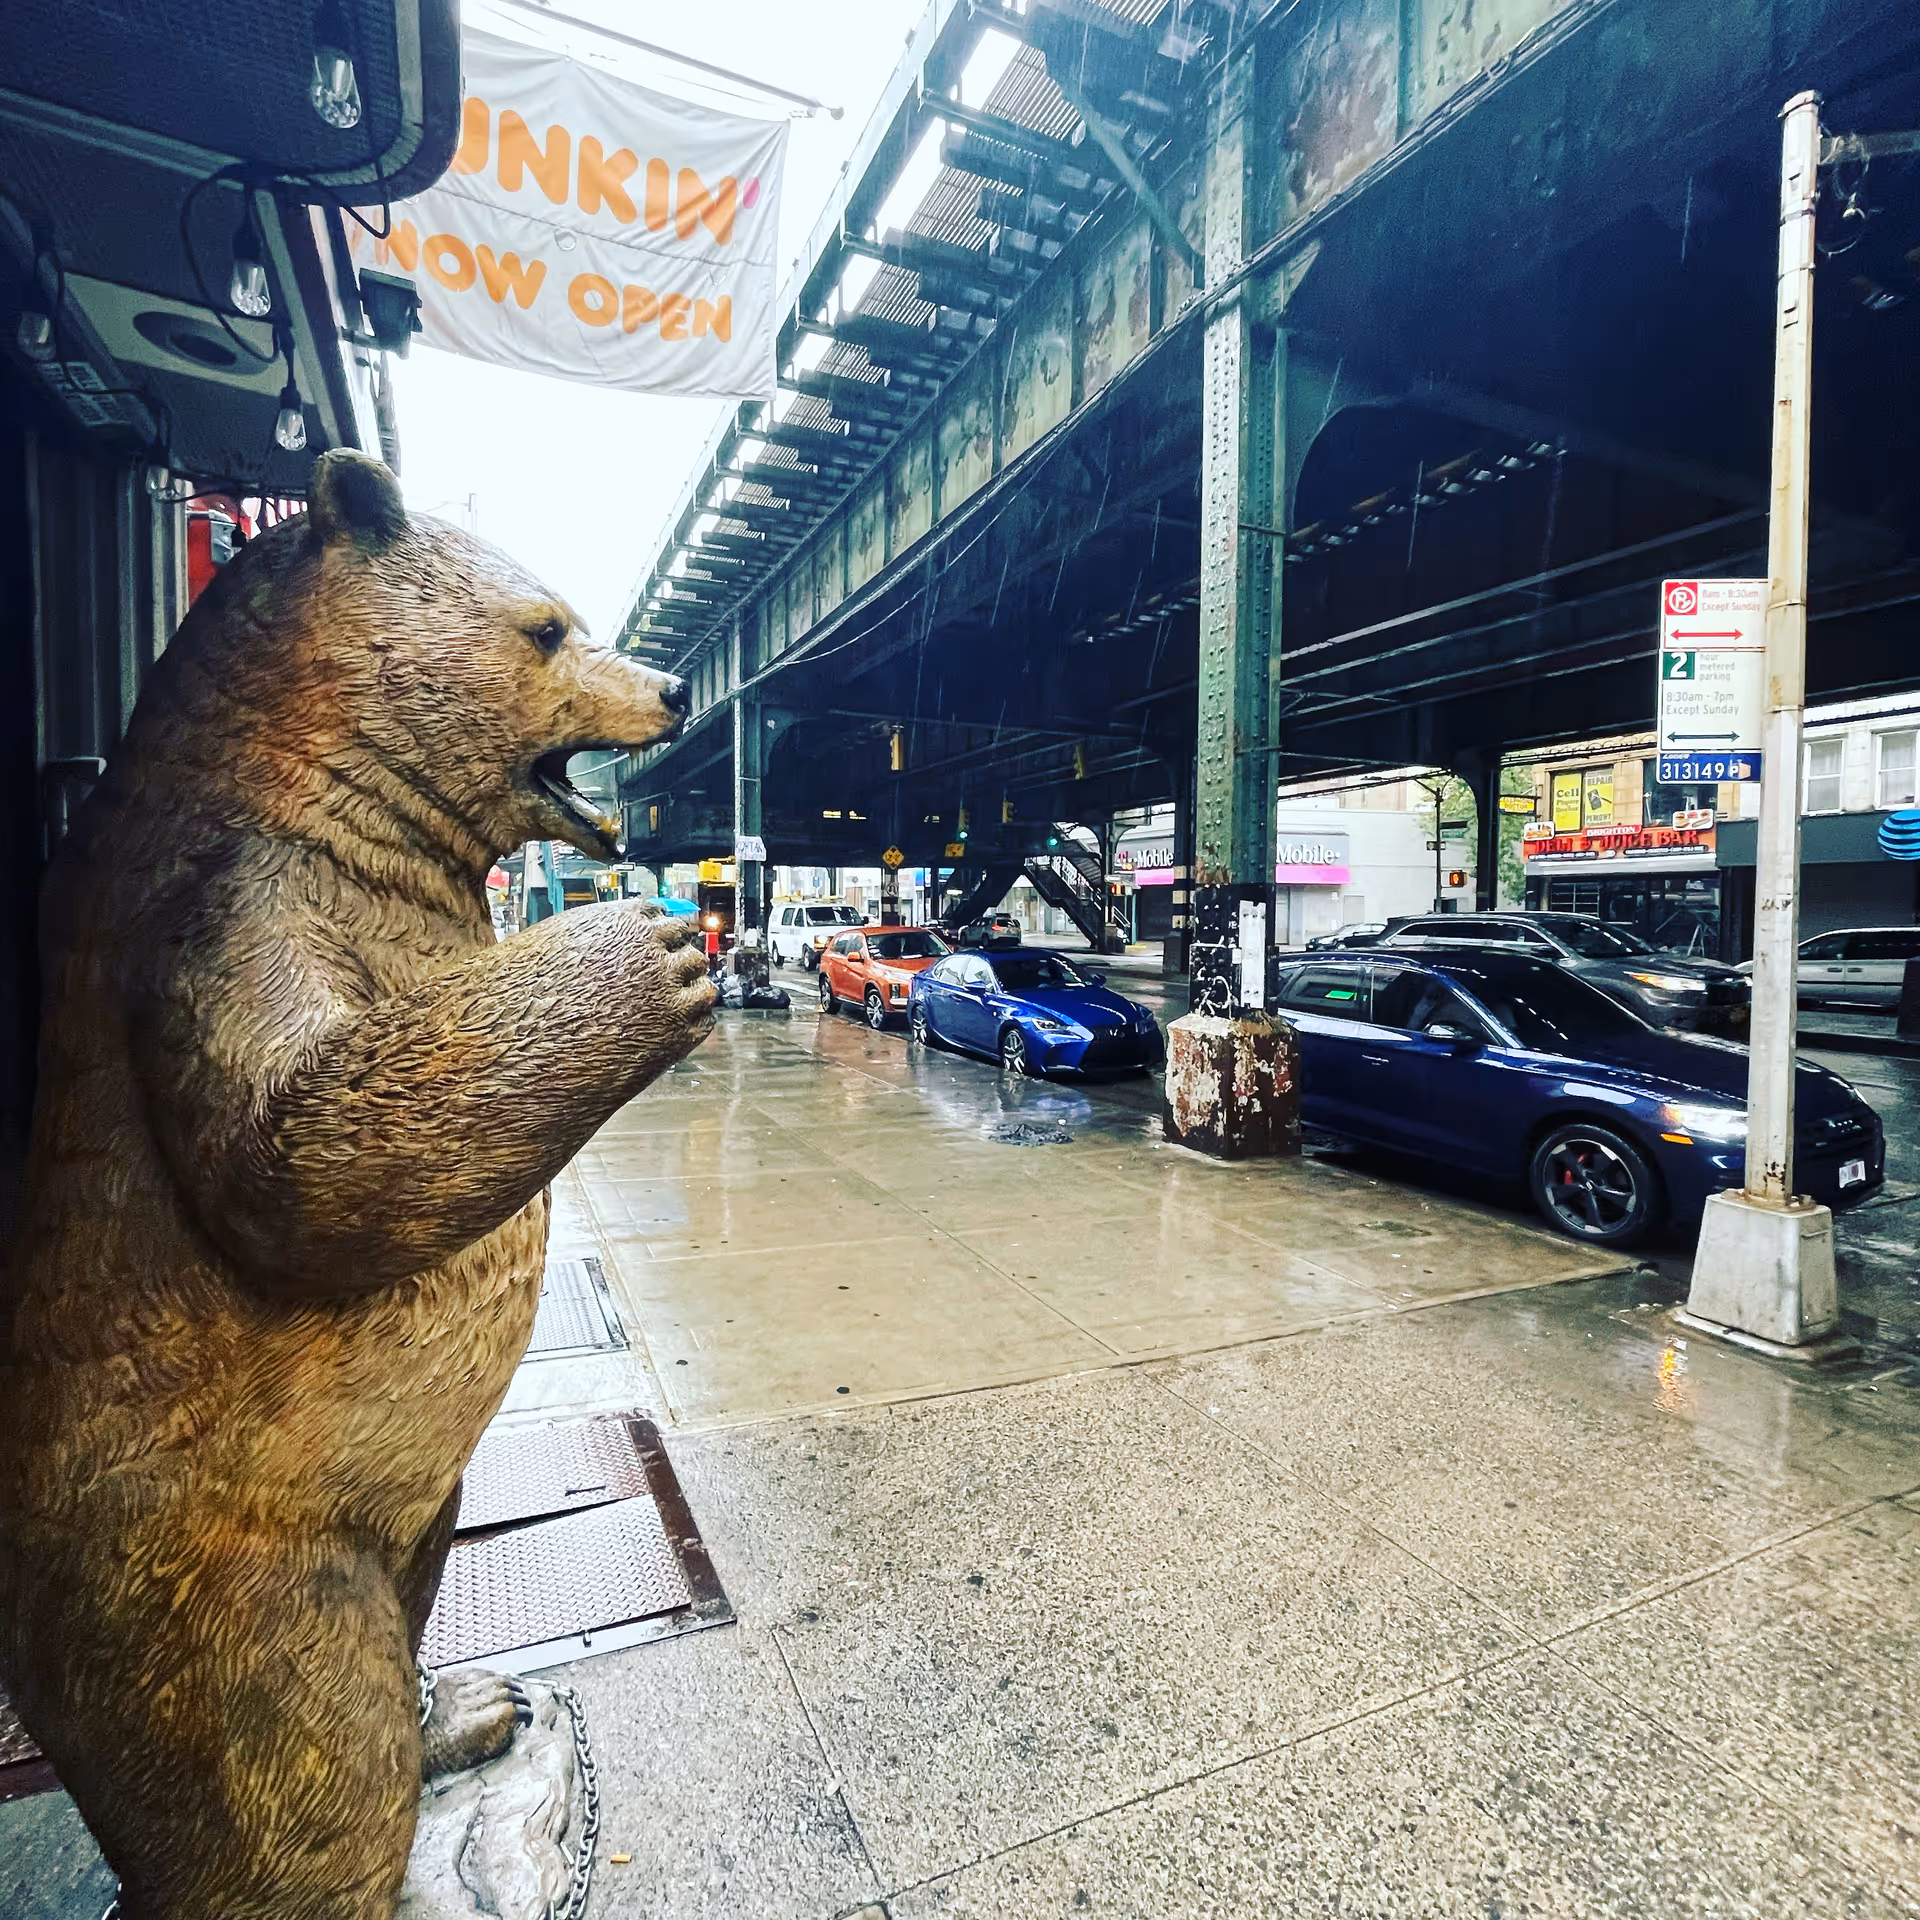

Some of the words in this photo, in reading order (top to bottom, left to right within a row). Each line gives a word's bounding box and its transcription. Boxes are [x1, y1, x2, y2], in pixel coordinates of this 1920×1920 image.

[450, 97, 760, 246] UNKIN'
[374, 207, 547, 310] NOW
[568, 273, 732, 343] OPEN
[1728, 589, 1759, 598] 8:30am
[1702, 602, 1729, 612] Except
[1732, 602, 1760, 612] Sunday
[1700, 653, 1719, 661] hour
[1670, 652, 1688, 678] 2
[1700, 662, 1735, 671] metered
[1700, 672, 1731, 681] parking
[1666, 691, 1703, 702] 8:30am
[1714, 691, 1734, 703] 7pm
[1666, 704, 1700, 716] Except
[1703, 704, 1740, 716] Sunday
[1661, 762, 1725, 780] 313149
[1556, 787, 1579, 798] Cell
[1586, 826, 1636, 837] BRIGHTON
[1536, 837, 1573, 853] DELI
[1600, 833, 1653, 849] JUICE
[1659, 829, 1699, 846] BAR
